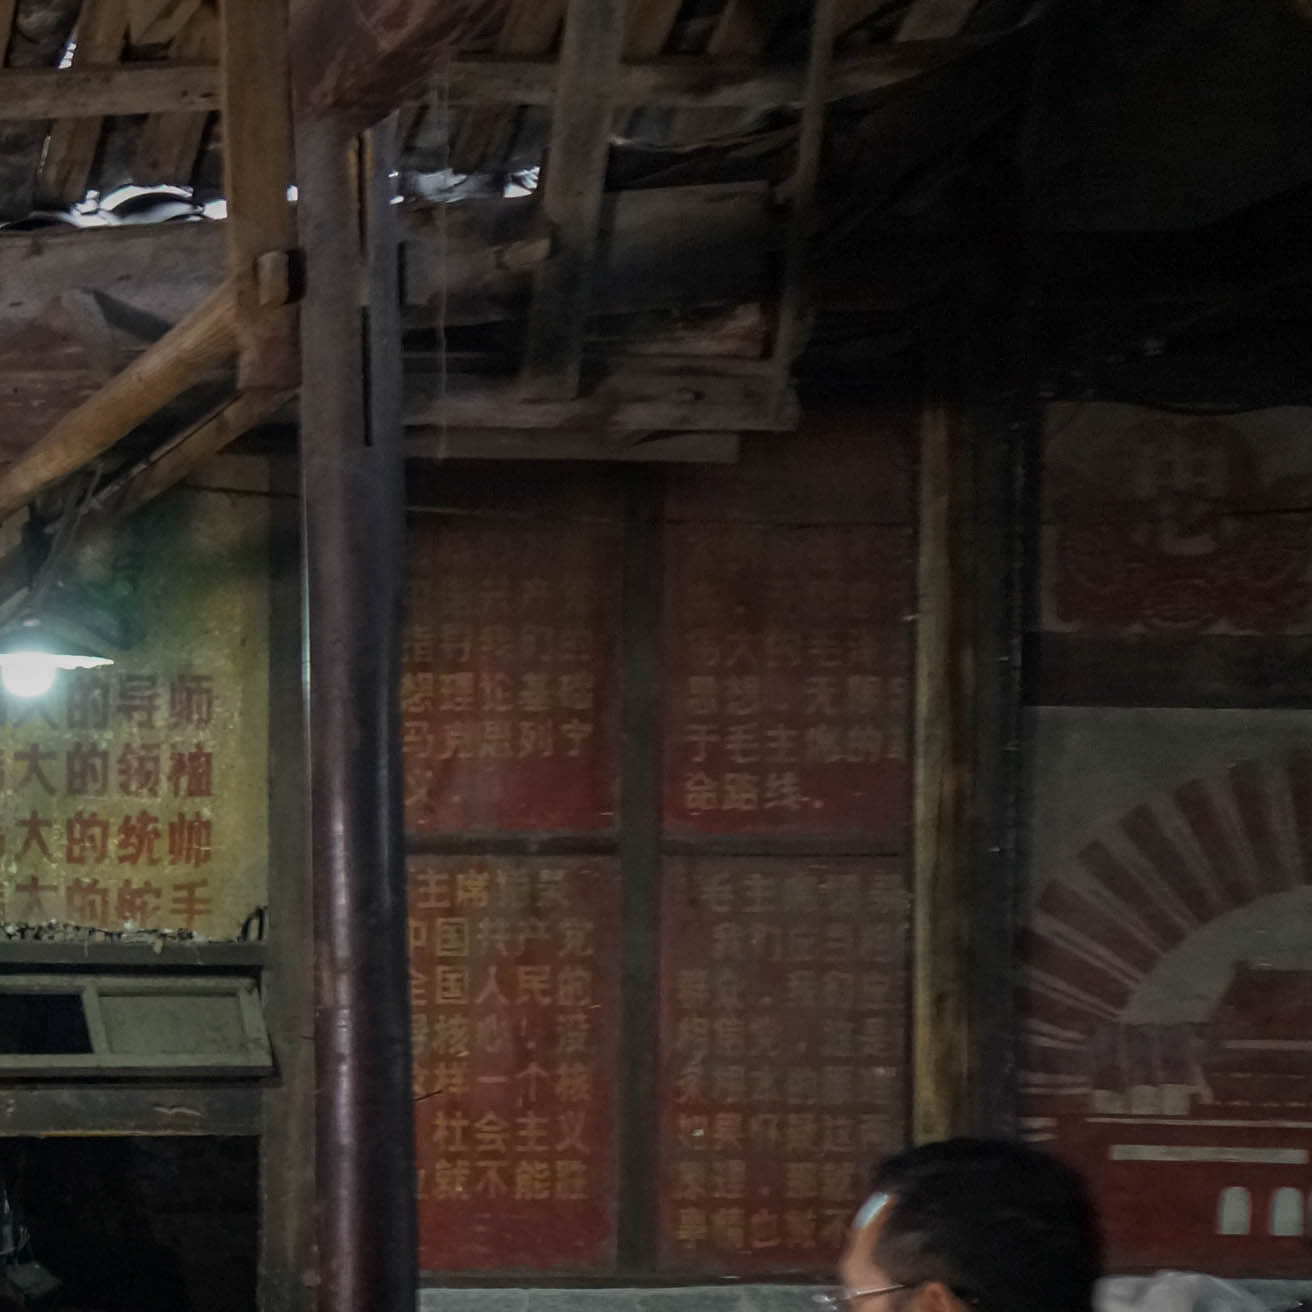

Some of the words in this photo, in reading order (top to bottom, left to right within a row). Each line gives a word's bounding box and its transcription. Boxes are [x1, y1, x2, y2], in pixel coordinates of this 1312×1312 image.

[409, 917, 596, 958] 中国共产党
